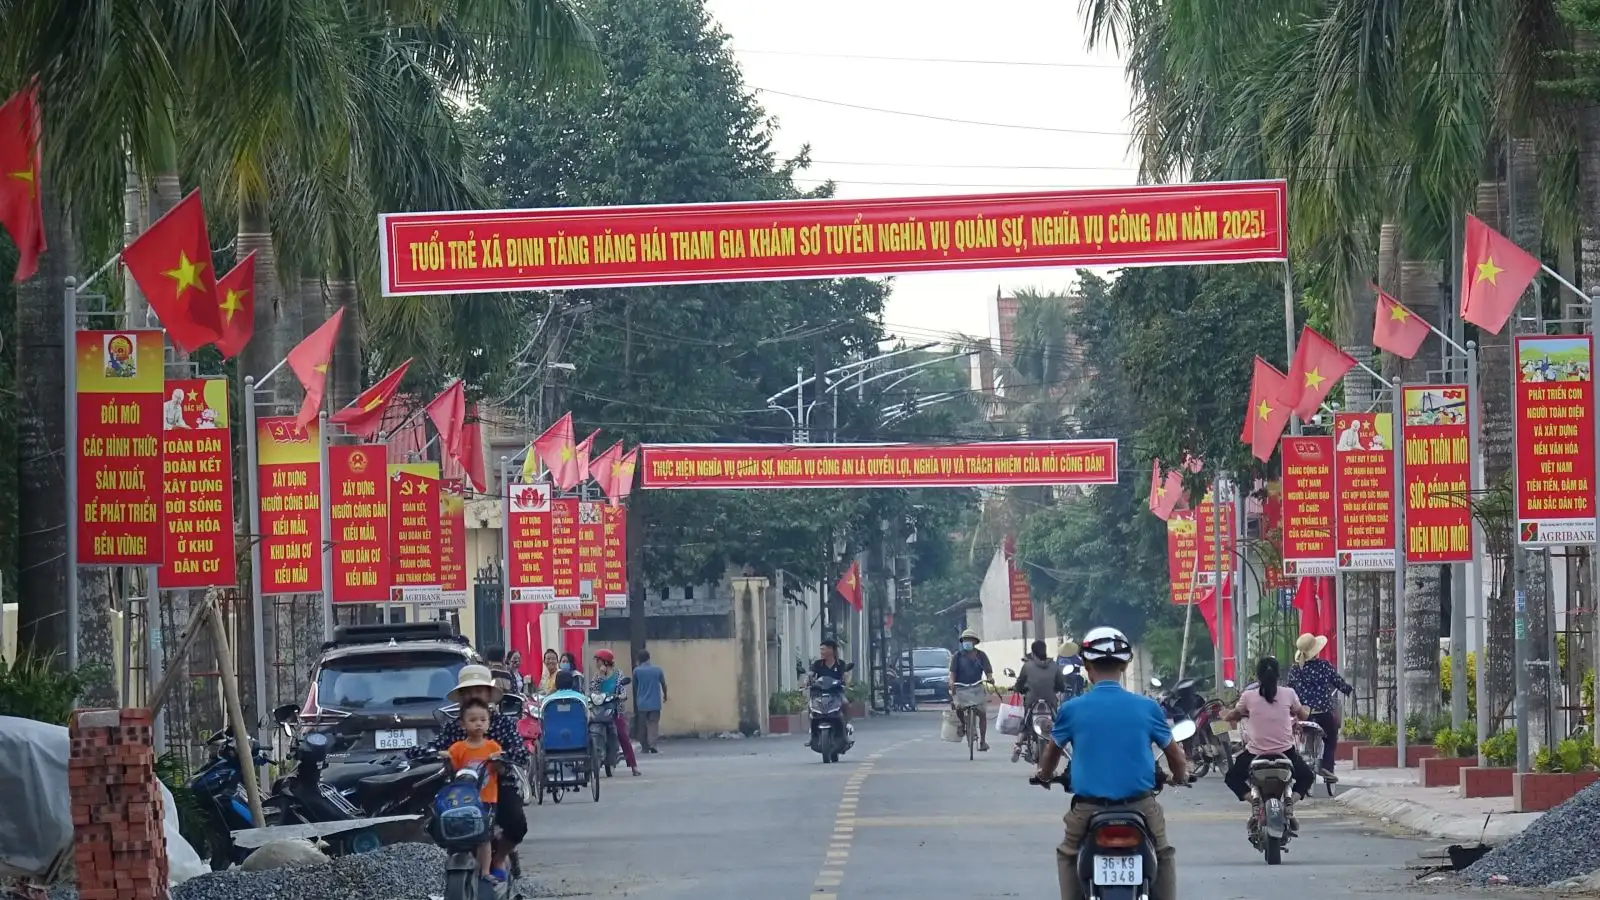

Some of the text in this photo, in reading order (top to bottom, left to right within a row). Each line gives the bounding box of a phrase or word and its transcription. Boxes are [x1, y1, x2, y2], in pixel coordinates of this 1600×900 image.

[410, 205, 1265, 274] TUỔI TRẺ XÃ ĐỊNH TĂNG HĂNG HÁI THAM GIA KHÁM SƠ TUYỂN NGHĨA VỤ QUÂN SỰ, NGHĨA VỤ CÔNG AN NĂM 2025!
[101, 398, 140, 424] ĐỔI MỚI
[84, 434, 157, 456] CÁC HÌNH THỨC
[164, 438, 221, 453] TOÀN DÂN
[1406, 432, 1468, 466] NÔNG THÔN MỚI
[164, 456, 221, 474] ĐOÀN KẾT
[653, 460, 673, 480] THỰC
[676, 458, 695, 480] HIỆN
[697, 458, 722, 476] NGHĨA
[724, 460, 735, 479] VỤ
[737, 457, 759, 477] QUÂN
[762, 459, 775, 479] SỰ,
[777, 457, 802, 475] NGHĨA
[804, 460, 815, 478] VỤ
[817, 456, 840, 475] CÔNG
[842, 459, 853, 475] AN
[856, 456, 866, 474] LÀ
[868, 455, 894, 476] QUYỀN
[914, 456, 939, 474] NGHĨA
[941, 458, 952, 477] VỤ
[953, 455, 964, 473] VÀ
[966, 455, 992, 473] TRÁCH
[995, 455, 1021, 476] NHIỆM
[1024, 453, 1040, 472] CỦA
[1060, 454, 1082, 472] CÔNG
[1085, 453, 1104, 472] DÂN!
[96, 464, 146, 491] SẢN XUẤT,
[164, 479, 222, 498] XÂY DỰNG
[1410, 475, 1466, 509] SỨC SỐNG MỚI
[101, 500, 126, 523] PHÁT
[128, 496, 156, 523] TRIỂN
[166, 495, 222, 514] ĐỜI SỐNG
[169, 520, 220, 533] VĂN HÓA
[178, 536, 213, 553] Ở KHU
[1410, 518, 1468, 559] DIỆN MẠO MỚI!
[1540, 531, 1597, 542] AGRIBANK
[174, 558, 220, 573] DÂN CƯ
[1299, 567, 1335, 575] AGRIBANK
[1353, 559, 1394, 567] AGRIBANK
[404, 593, 441, 601] AGRIBANK
[1102, 871, 1135, 883] 1348
